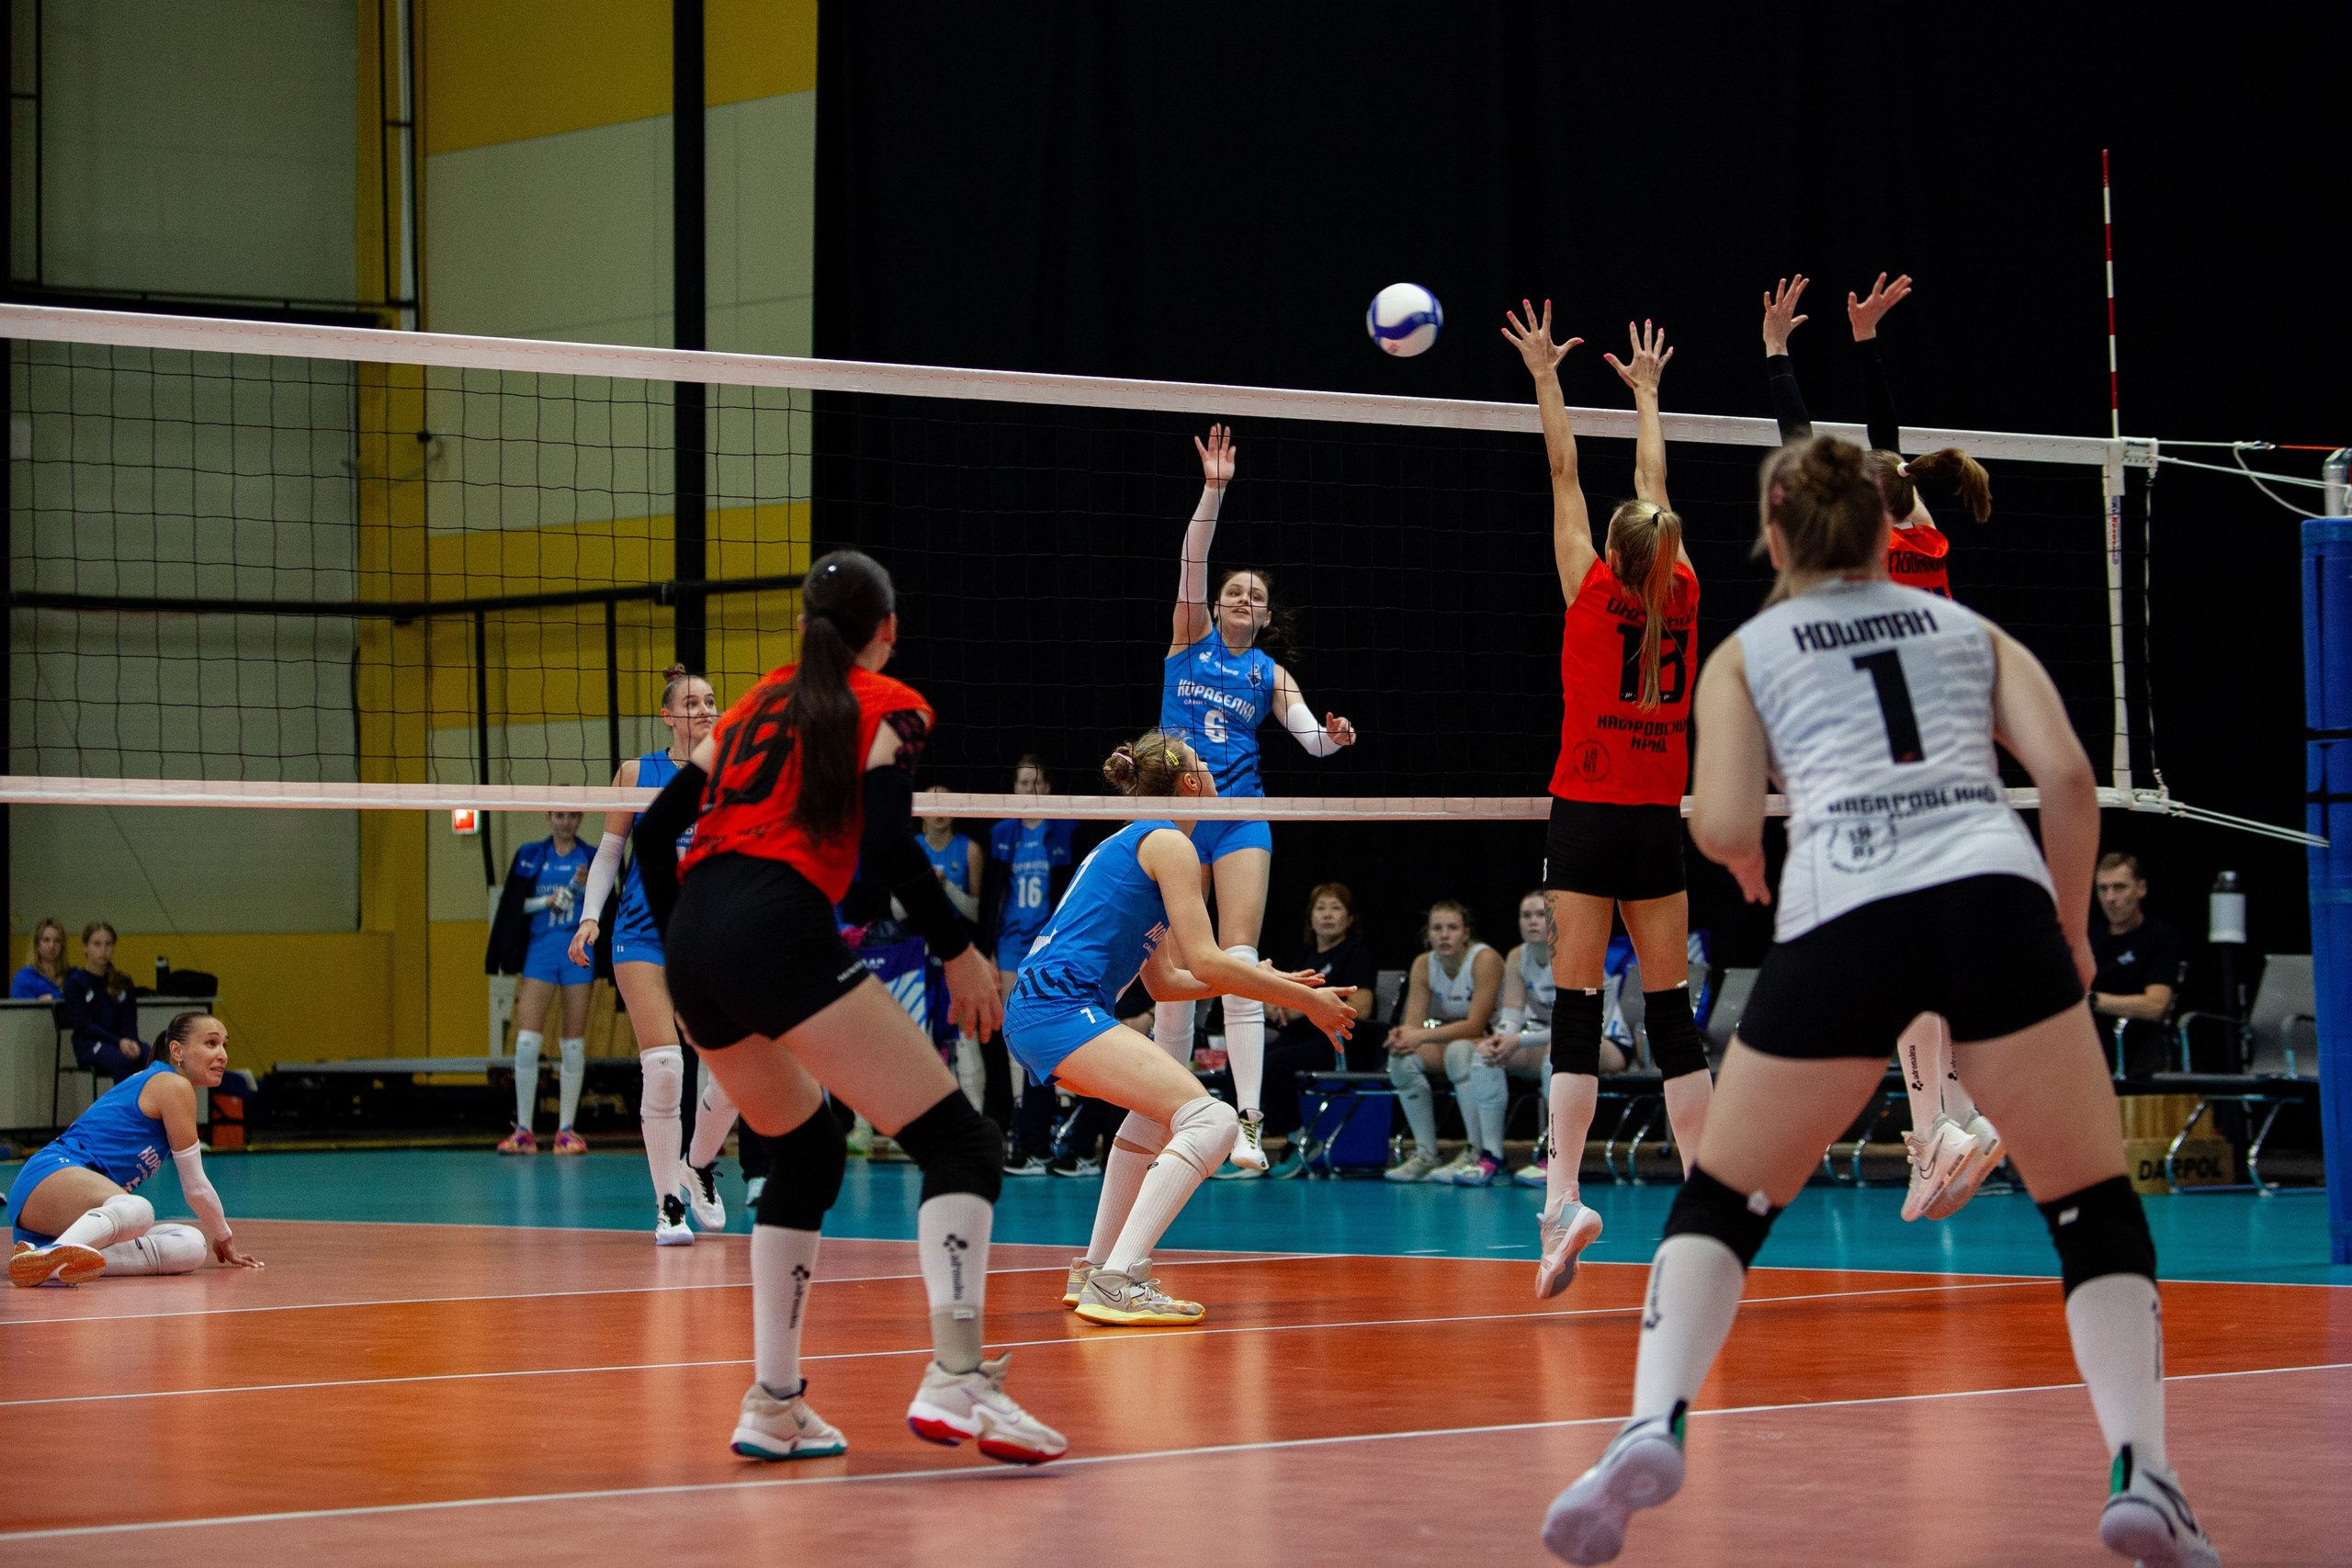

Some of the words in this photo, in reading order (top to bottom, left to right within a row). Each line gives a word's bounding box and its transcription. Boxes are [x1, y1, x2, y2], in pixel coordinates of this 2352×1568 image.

[1177, 678, 1256, 723] КОРАБЕЛКА
[1851, 649, 1926, 765] 1
[1204, 708, 1228, 744] 6
[1018, 876, 1043, 908] 16
[1080, 1007, 1096, 1025] 7
